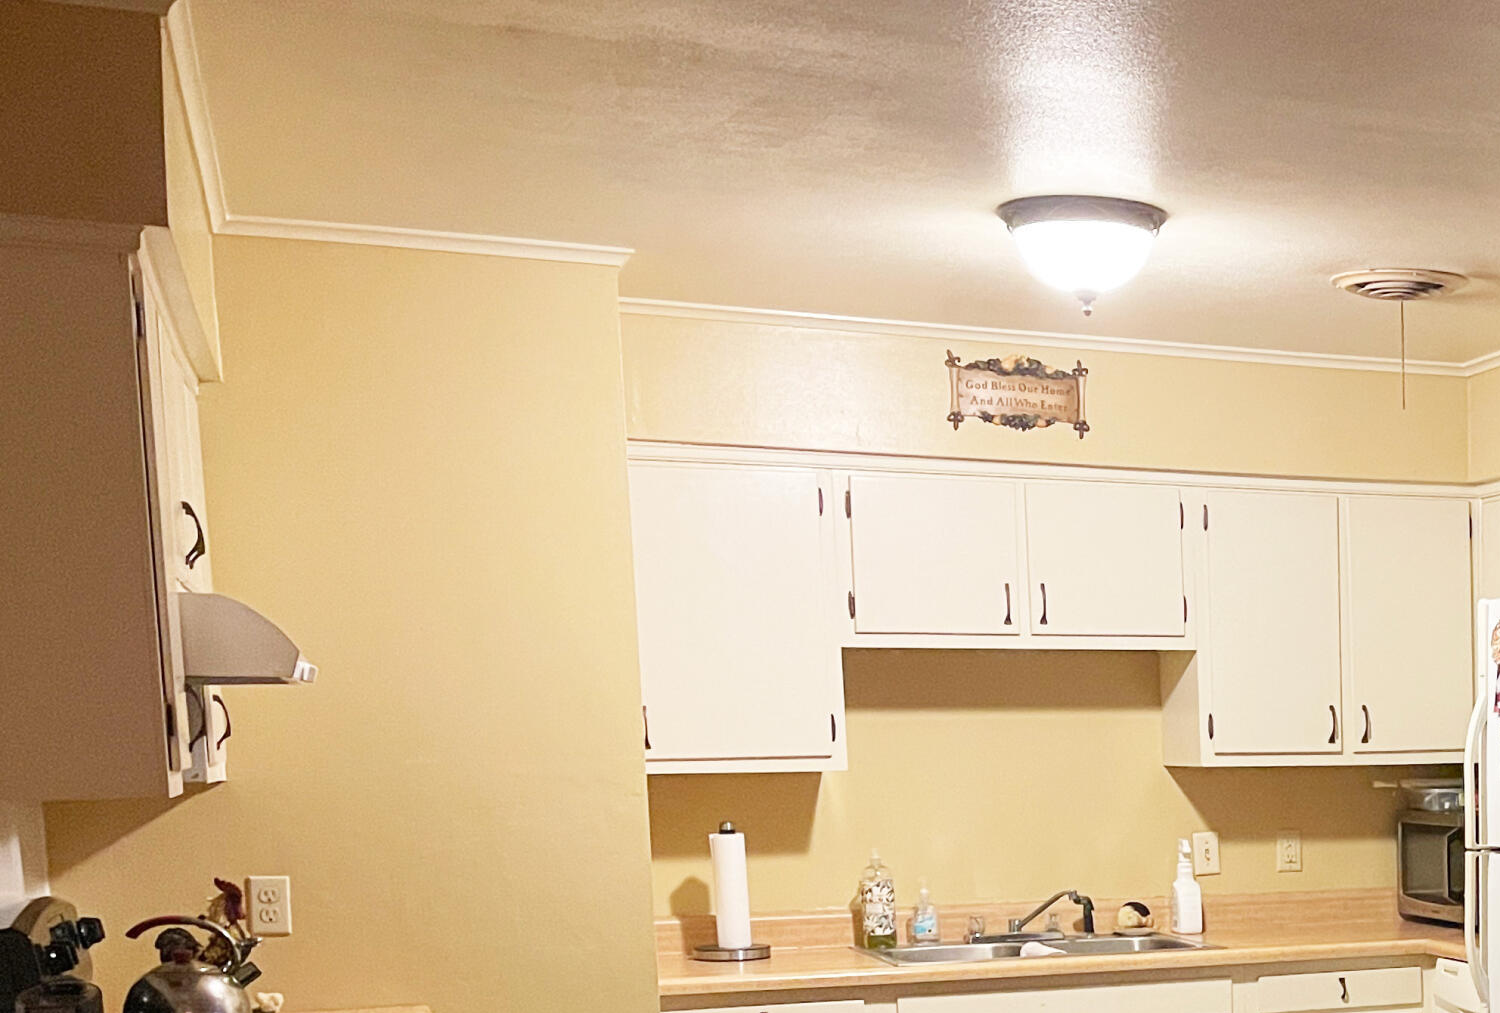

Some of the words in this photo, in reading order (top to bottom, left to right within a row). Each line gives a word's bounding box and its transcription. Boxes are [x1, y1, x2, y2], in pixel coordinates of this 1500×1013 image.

[965, 380, 988, 390] God
[991, 380, 1015, 392] Bless
[1018, 383, 1039, 393] Our
[1041, 385, 1071, 396] Home
[970, 396, 993, 406] And
[996, 397, 1013, 407] All
[1014, 398, 1038, 409] Who
[1041, 400, 1068, 412] Enter
